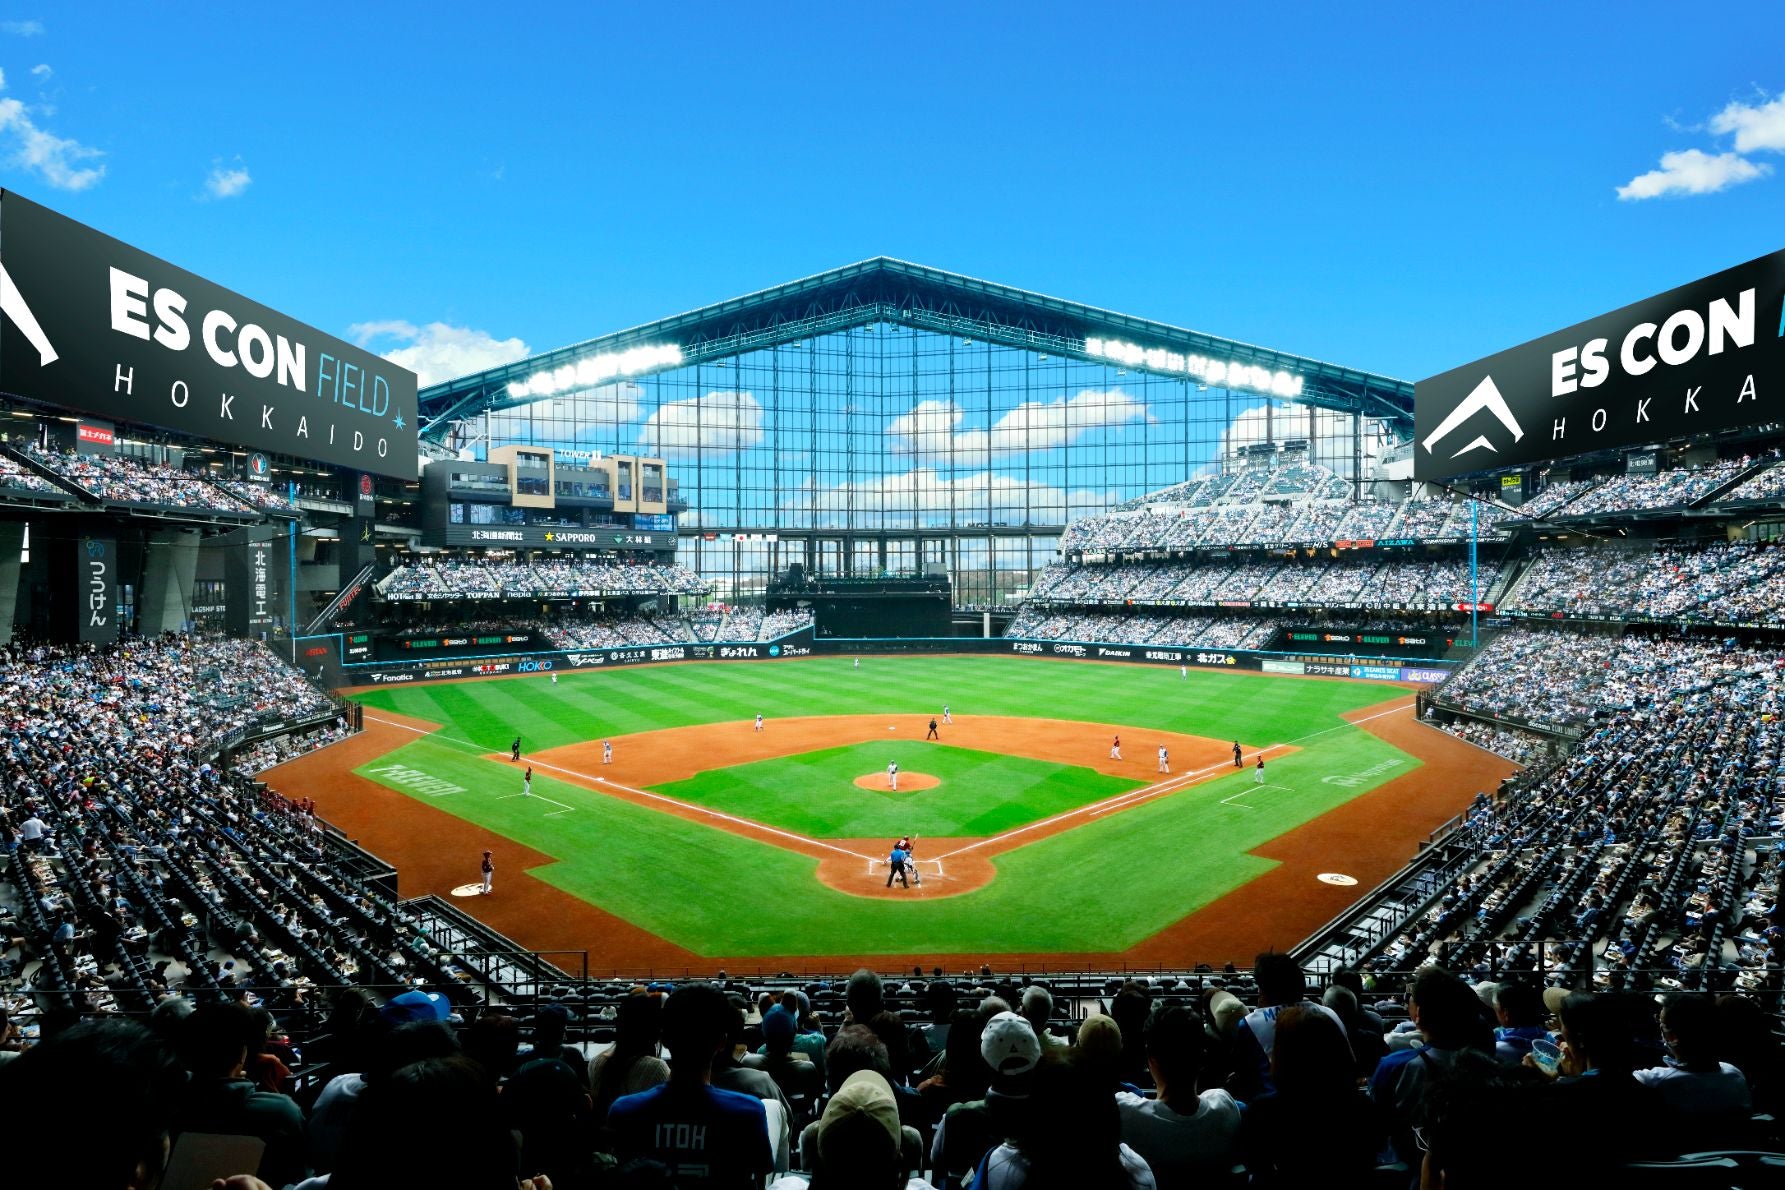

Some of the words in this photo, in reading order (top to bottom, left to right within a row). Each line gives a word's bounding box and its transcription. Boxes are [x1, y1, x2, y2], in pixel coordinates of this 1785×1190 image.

[110, 266, 191, 351] ES
[202, 310, 306, 392] CON
[317, 353, 390, 418] FIELD
[1552, 338, 1610, 398] ES
[1620, 287, 1756, 376] CON
[114, 363, 388, 458] HOKKAIDO
[559, 449, 590, 459] TOWER
[555, 533, 596, 543] SAPPORO
[255, 550, 267, 616] 北海電工
[89, 561, 107, 627] つうけん
[720, 646, 758, 658] ぎょれん
[1197, 653, 1227, 664] 北ガス
[1306, 664, 1350, 676] ナラサキ産業
[383, 673, 414, 683] Fanatics
[1527, 720, 1551, 731] docomo
[656, 1123, 707, 1150] ITOH
